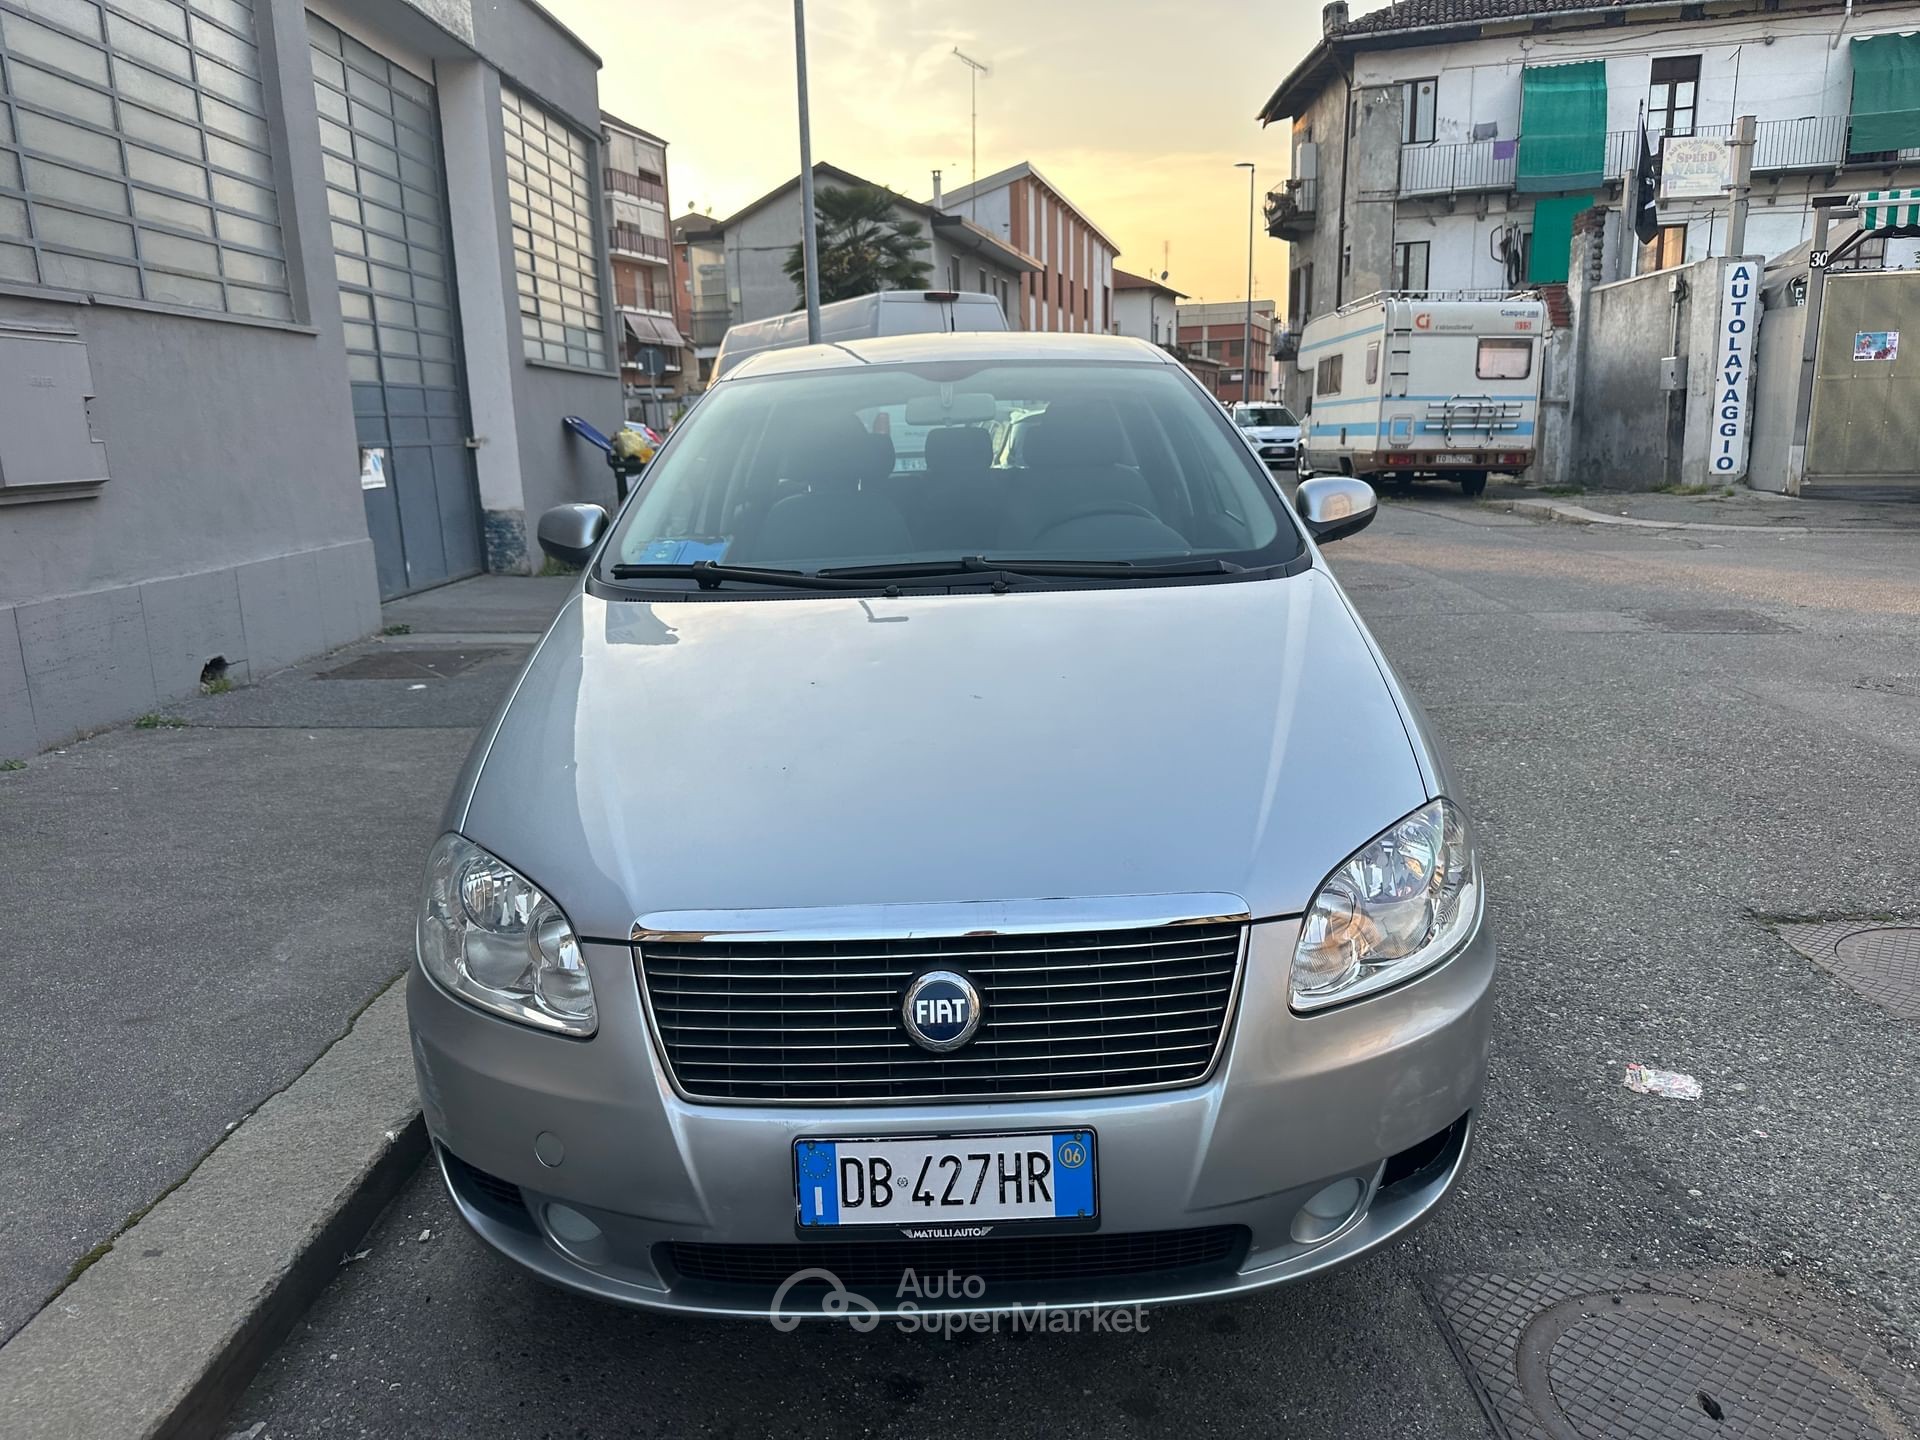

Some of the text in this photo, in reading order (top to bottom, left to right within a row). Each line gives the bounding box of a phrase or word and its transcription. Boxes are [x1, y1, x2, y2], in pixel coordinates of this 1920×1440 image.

[1676, 151, 1717, 163] SPEED
[1811, 252, 1828, 267] 30
[1716, 265, 1750, 471] AUTOLAVAGGIO
[916, 999, 966, 1024] FIAT
[840, 1157, 894, 1208] DB
[911, 1150, 1053, 1207] 427HR
[1063, 1147, 1082, 1164] 06
[913, 1227, 981, 1239] MATULLI AUTO
